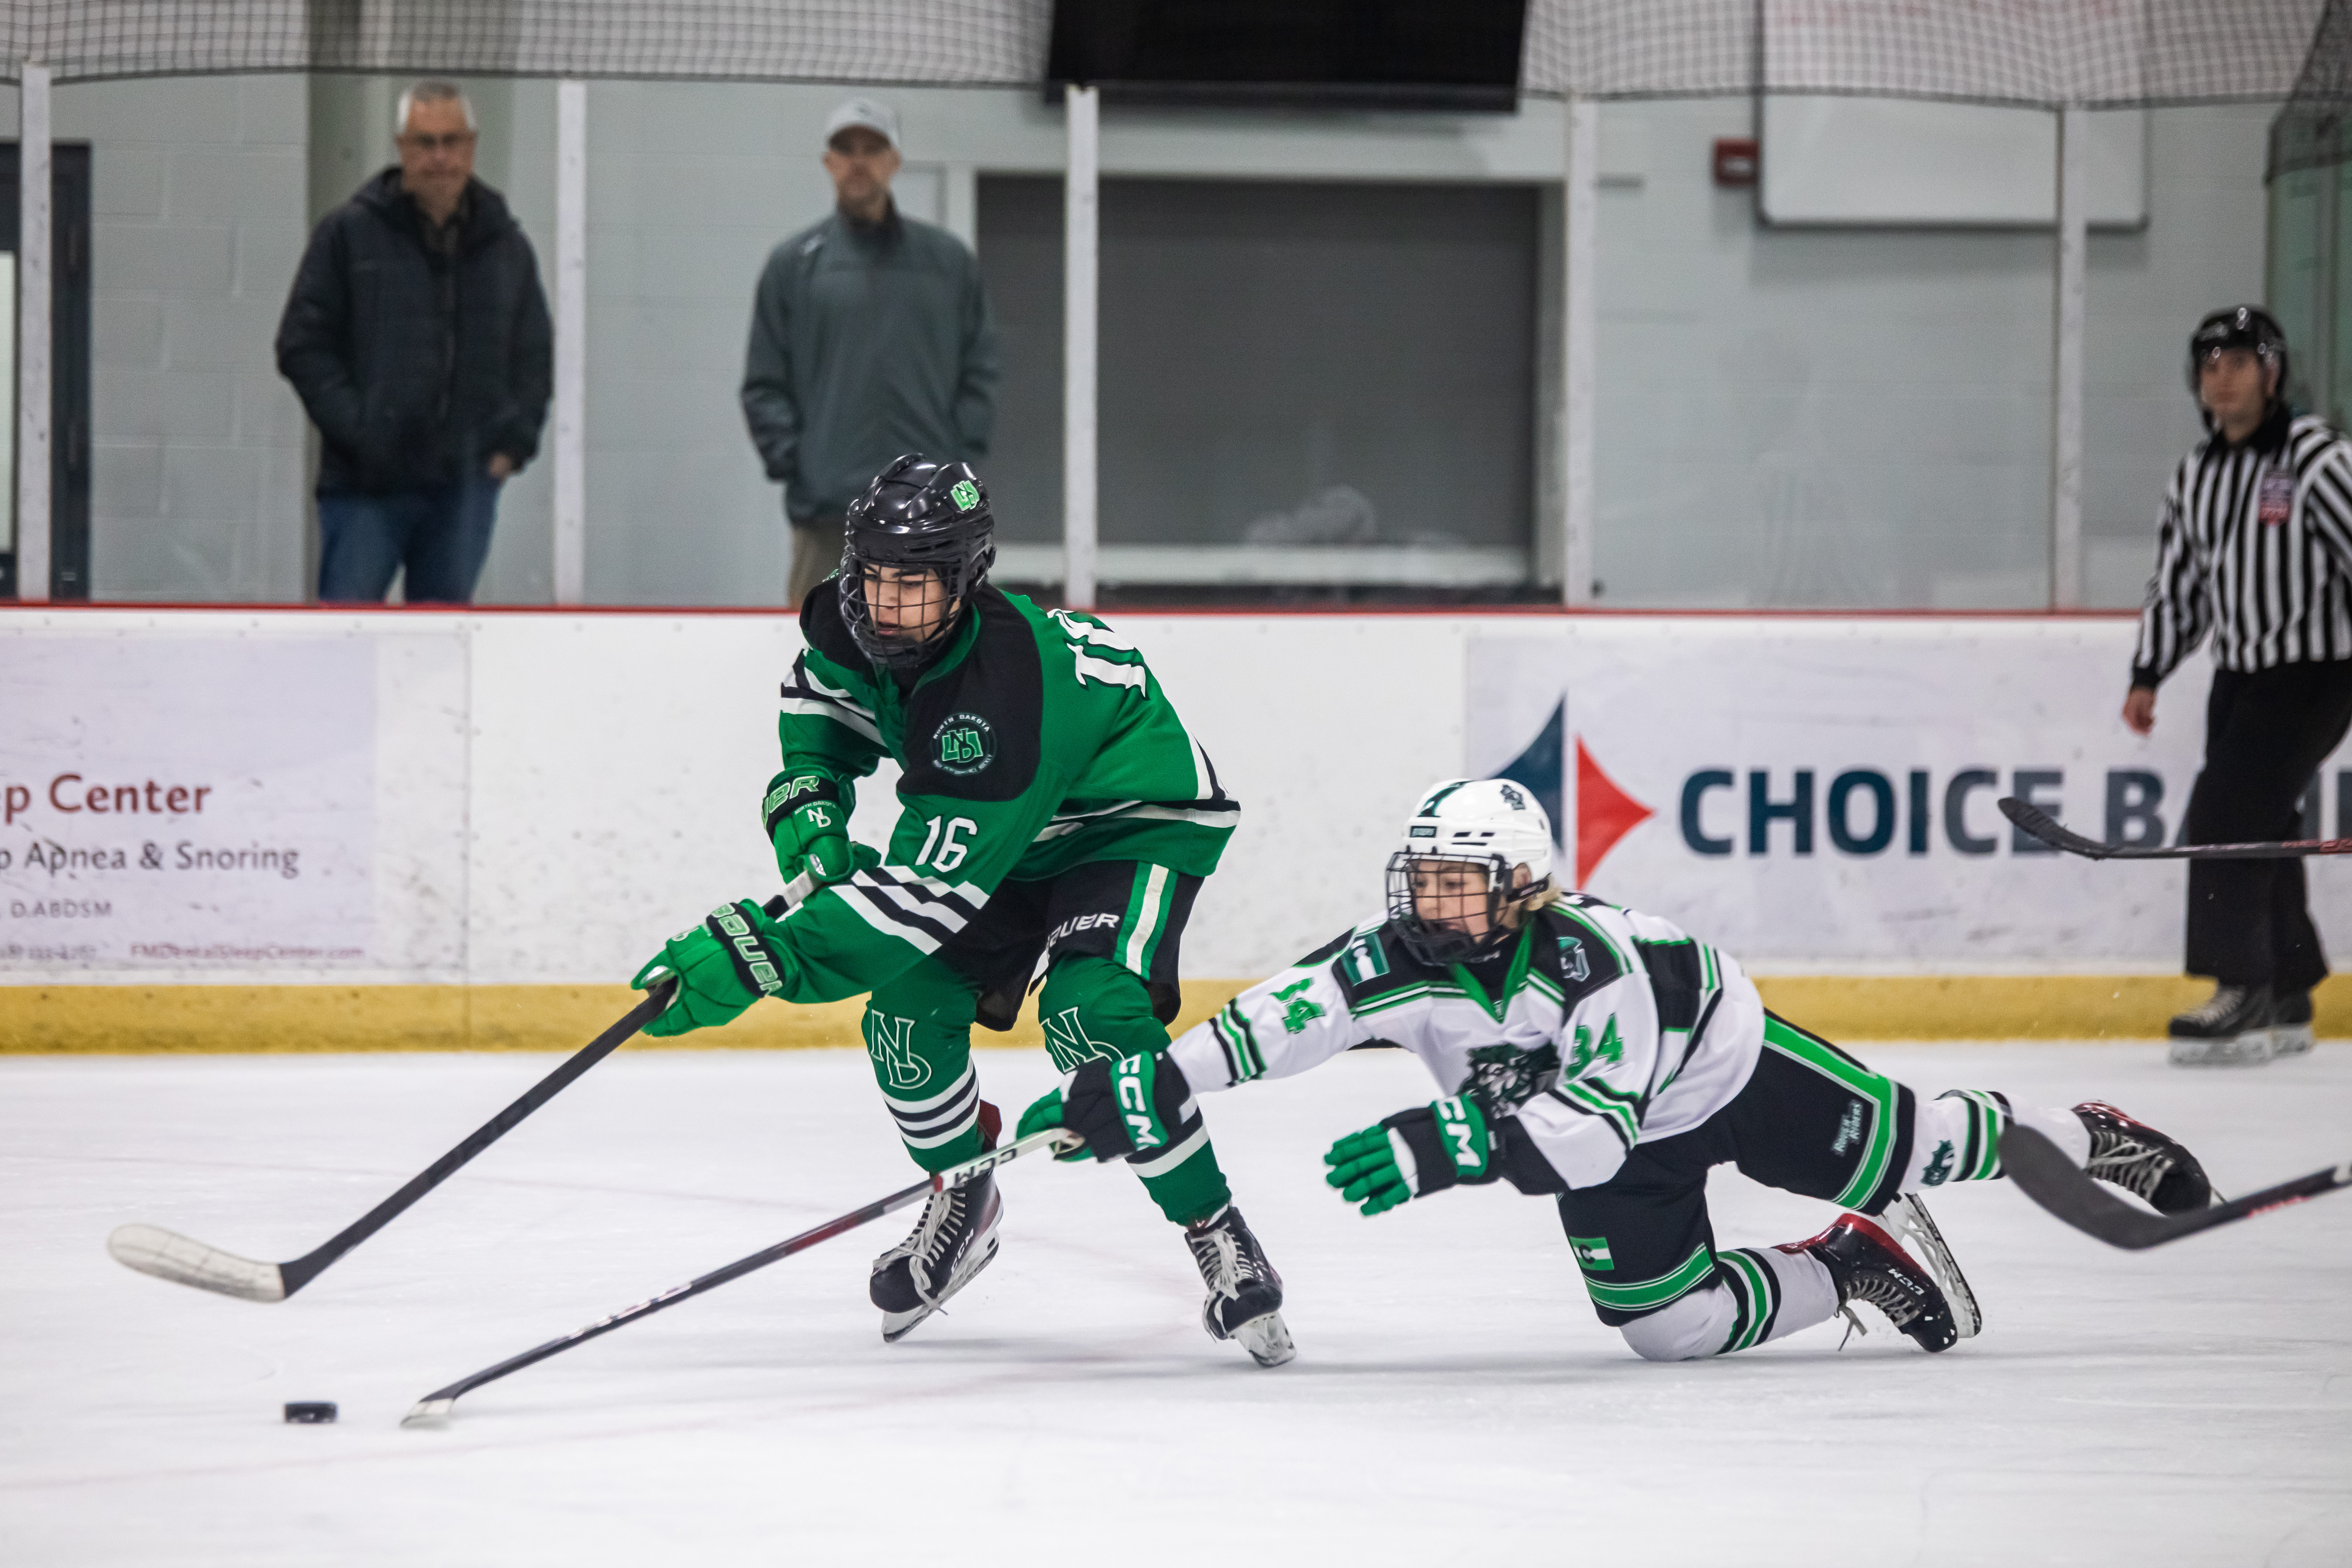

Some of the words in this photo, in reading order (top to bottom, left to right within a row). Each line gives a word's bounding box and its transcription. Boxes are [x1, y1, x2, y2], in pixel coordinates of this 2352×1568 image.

[959, 714, 990, 732] DAKOTA
[48, 773, 212, 814] Center
[794, 803, 812, 815] NORTH
[813, 800, 837, 809] DAKOTA
[1679, 768, 2065, 856] CHOICE
[806, 806, 832, 828] ND
[24, 841, 127, 877] Apnea
[139, 841, 164, 870] &
[175, 839, 301, 879] Snoring
[916, 816, 978, 873] 16
[1045, 913, 1120, 962] AUER
[871, 1008, 932, 1089] ND
[1565, 1012, 1624, 1081] 34
[1118, 1054, 1161, 1145] CCM
[951, 1228, 974, 1274] CCM
[1888, 1268, 1925, 1295] CCM
